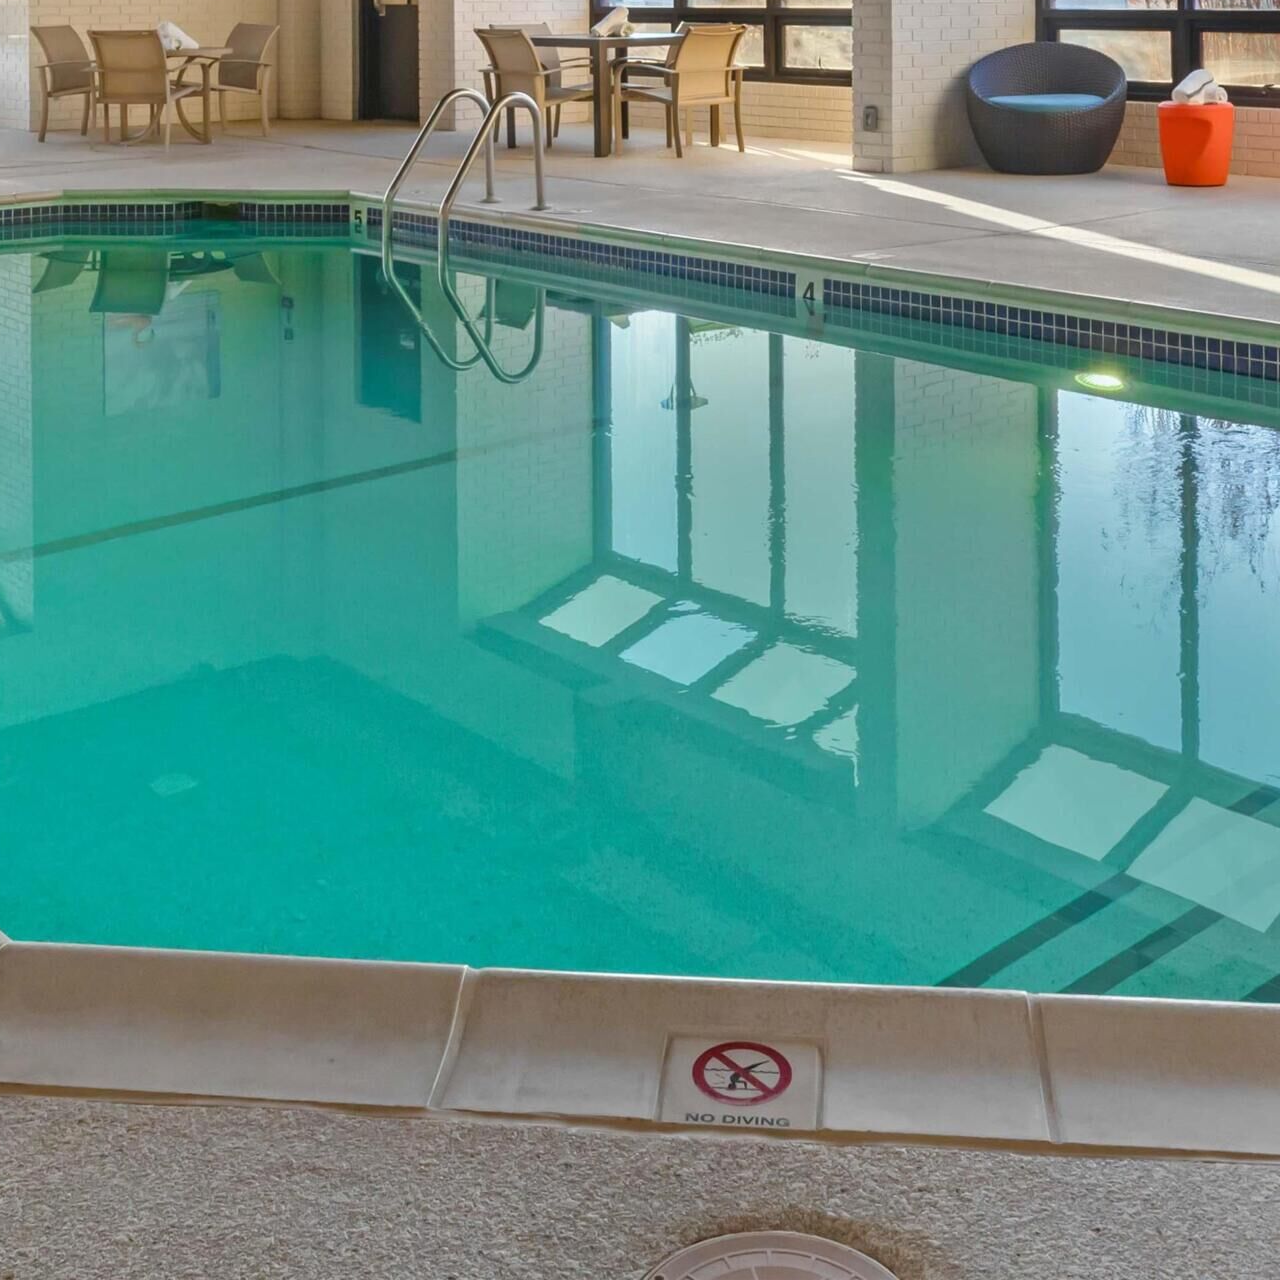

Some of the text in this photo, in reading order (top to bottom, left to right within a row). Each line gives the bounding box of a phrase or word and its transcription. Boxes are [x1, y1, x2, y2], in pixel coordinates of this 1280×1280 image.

[802, 281, 816, 301] 4
[685, 1113, 790, 1127] NO DIVING
